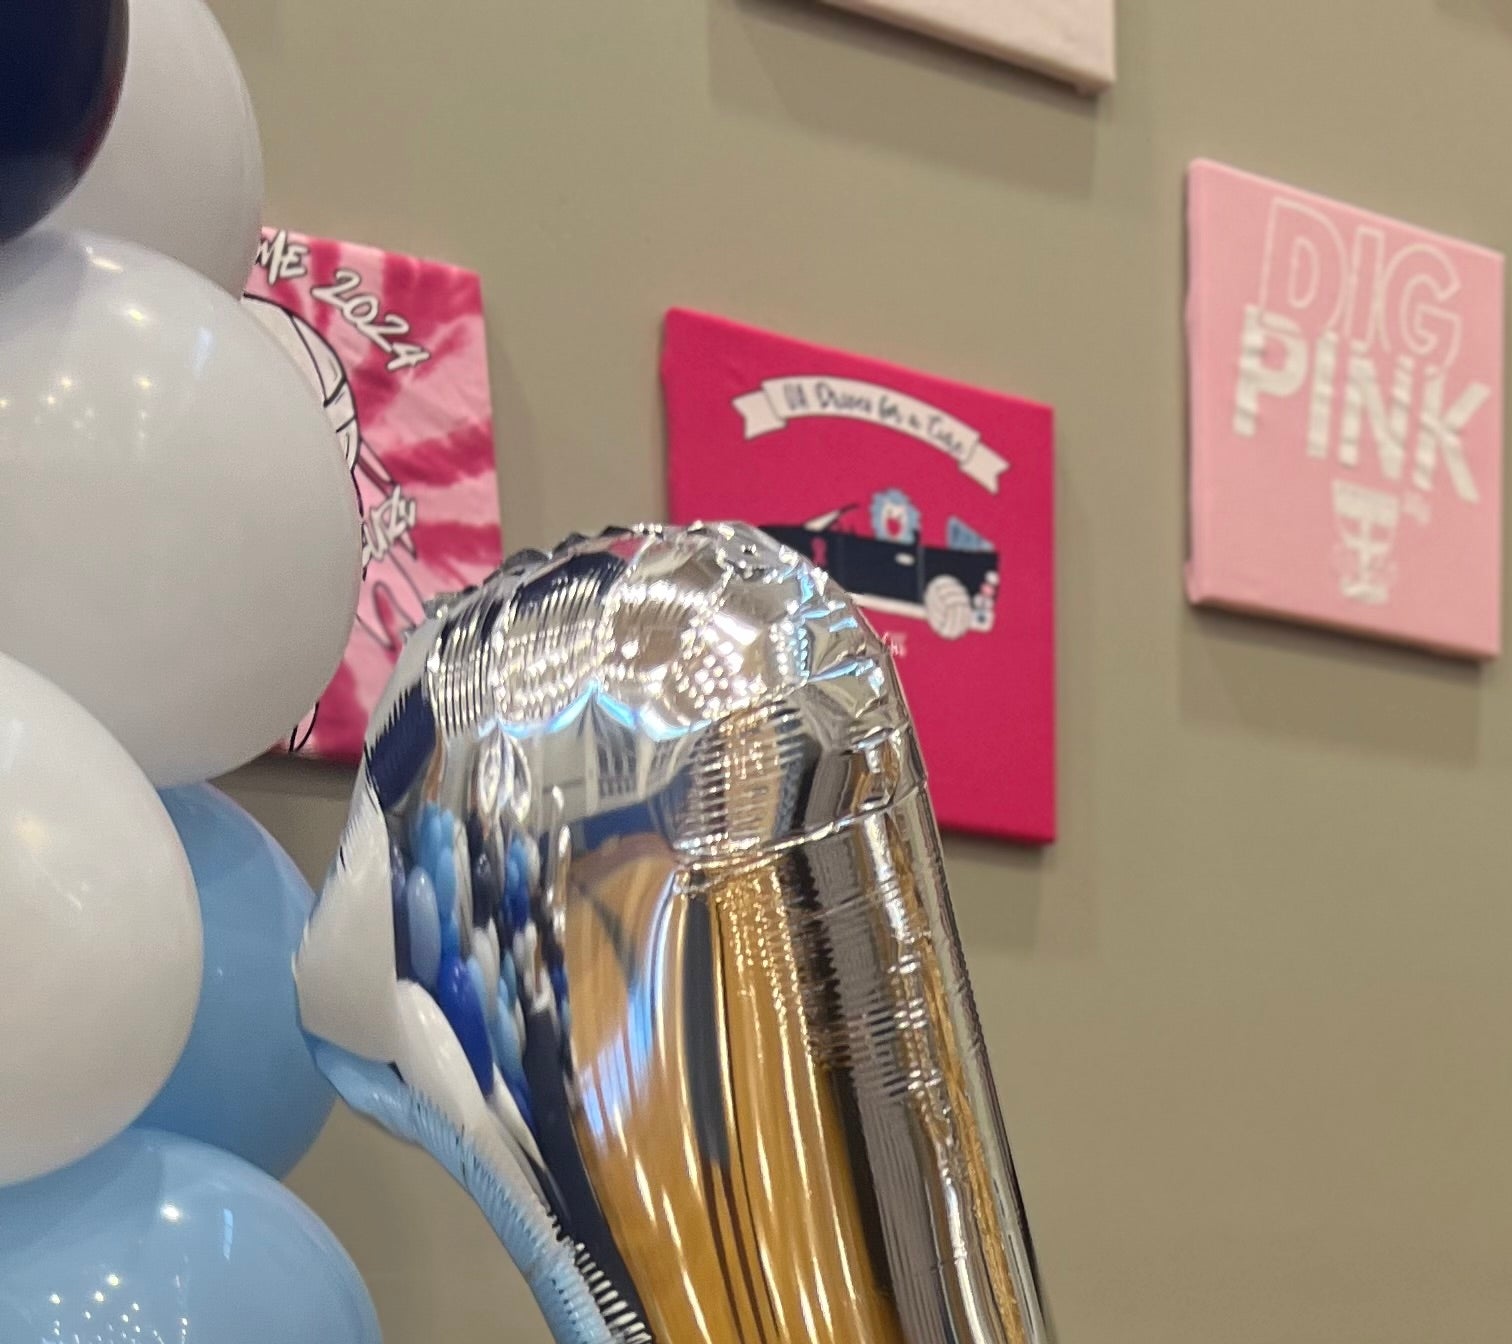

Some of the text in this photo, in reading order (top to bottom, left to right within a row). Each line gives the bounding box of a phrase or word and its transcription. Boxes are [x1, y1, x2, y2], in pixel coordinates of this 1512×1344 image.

[255, 229, 432, 373] ME 2024
[1258, 195, 1461, 372] DIG
[1231, 303, 1492, 505] PINK
